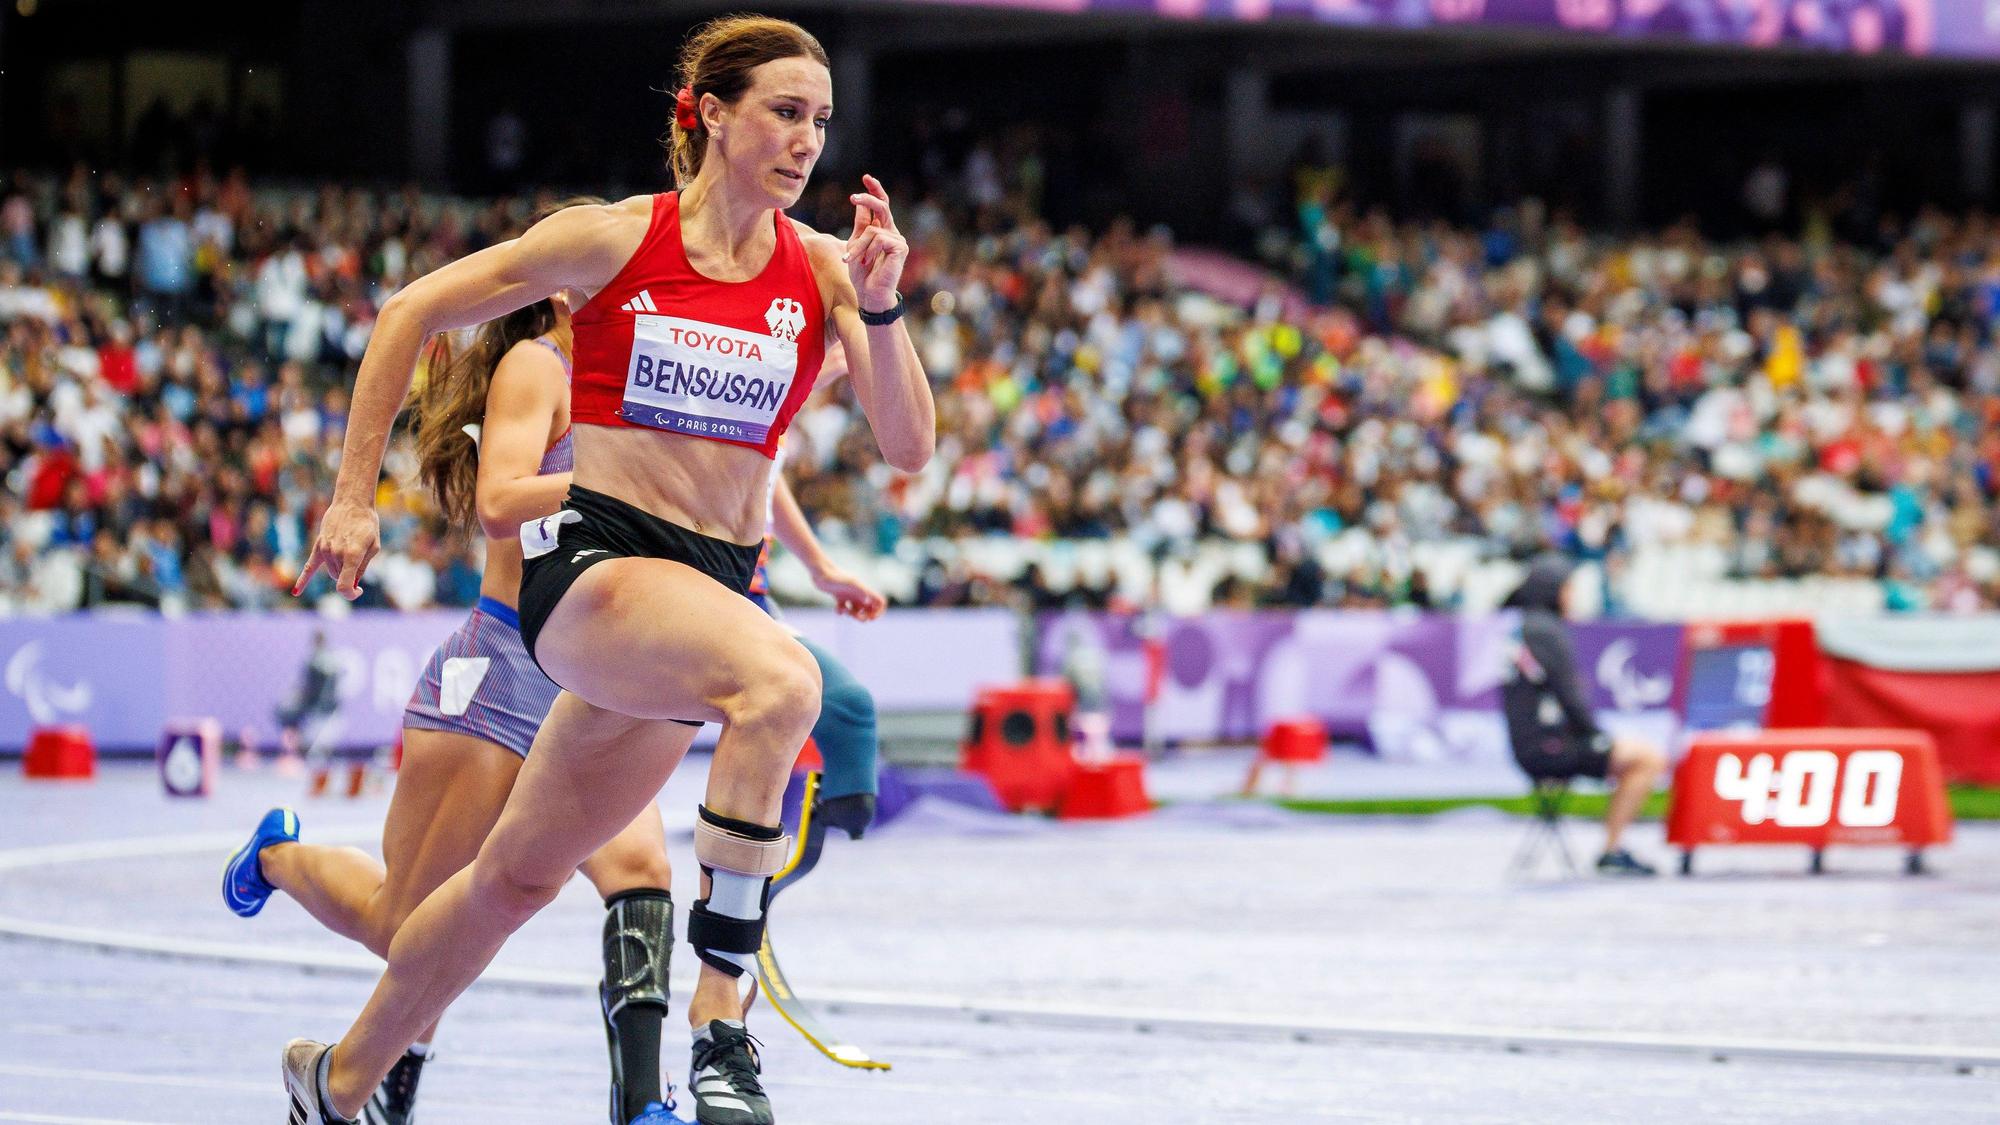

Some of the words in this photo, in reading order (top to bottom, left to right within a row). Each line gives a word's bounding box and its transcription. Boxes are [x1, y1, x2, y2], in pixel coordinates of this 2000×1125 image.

[670, 328, 763, 361] TOYOTA
[634, 354, 786, 411] BENSUSAN
[711, 423, 742, 436] 2024
[1714, 750, 1904, 827] 4:00
